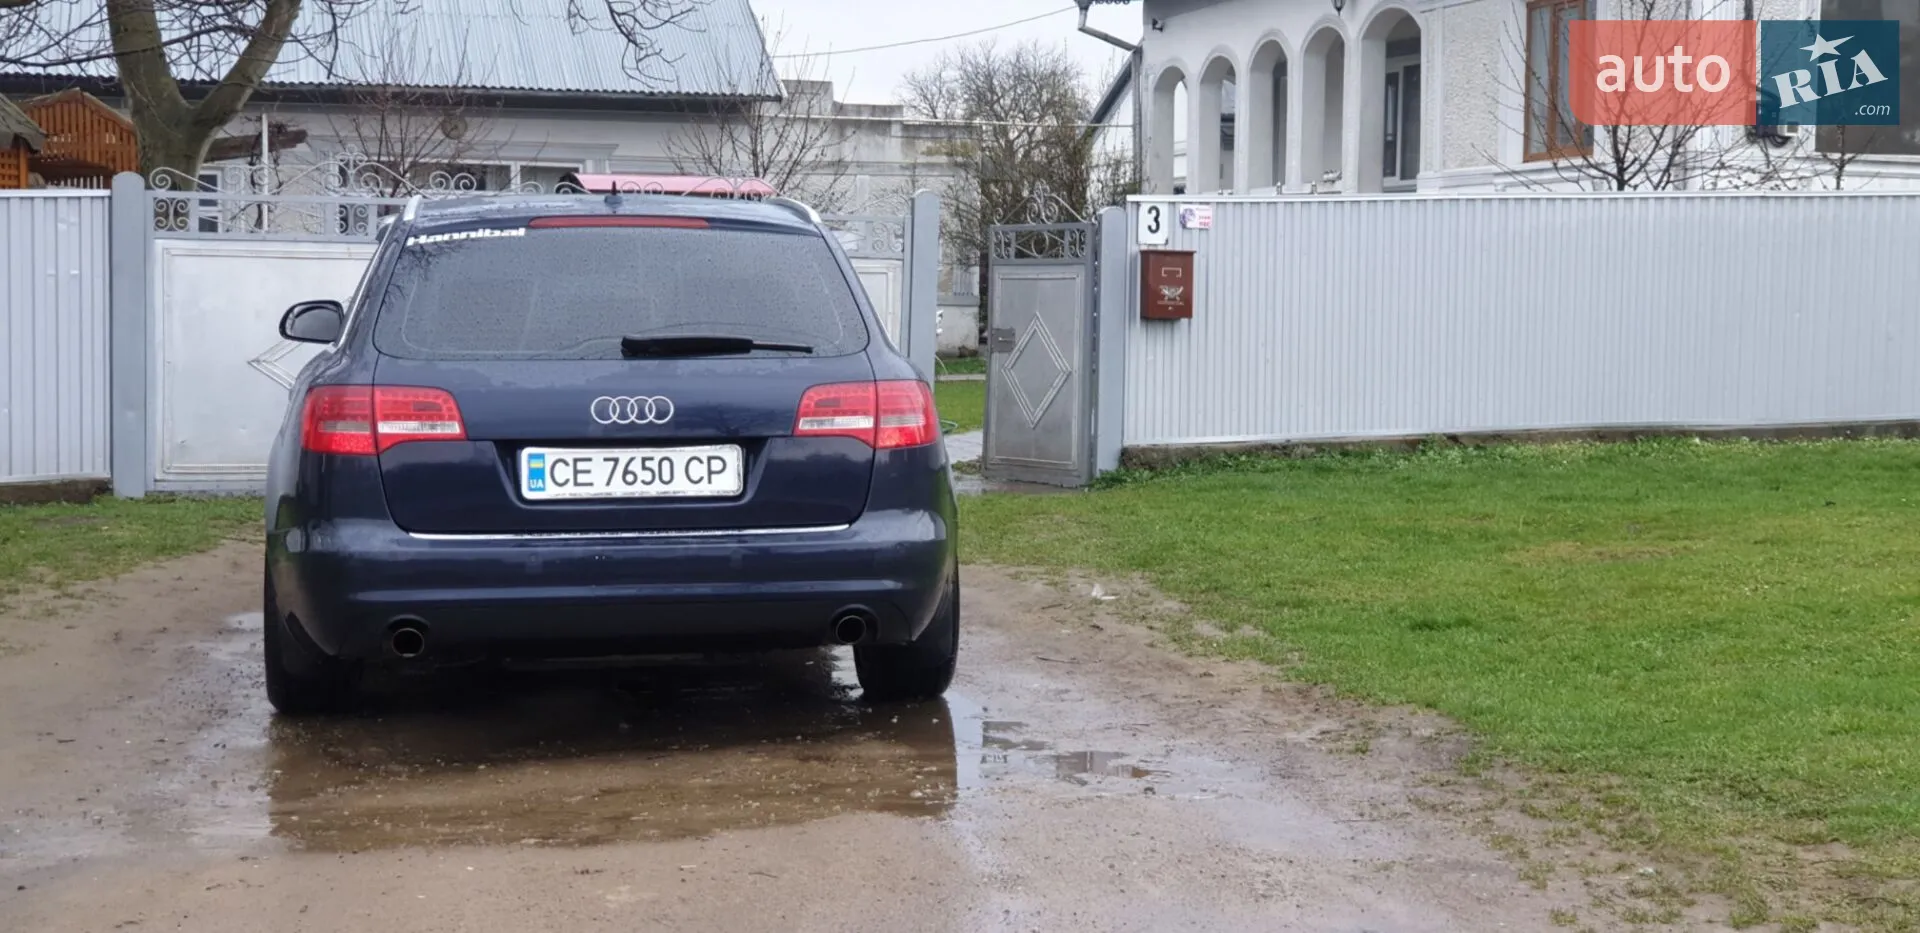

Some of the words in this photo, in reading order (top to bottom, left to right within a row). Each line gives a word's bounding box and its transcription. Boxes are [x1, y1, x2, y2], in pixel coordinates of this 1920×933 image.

[1147, 205, 1160, 234] 3
[406, 227, 525, 247] Hannibal
[549, 457, 594, 487] CE
[602, 455, 674, 487] 7650
[684, 455, 727, 485] CP
[529, 479, 544, 489] UA
